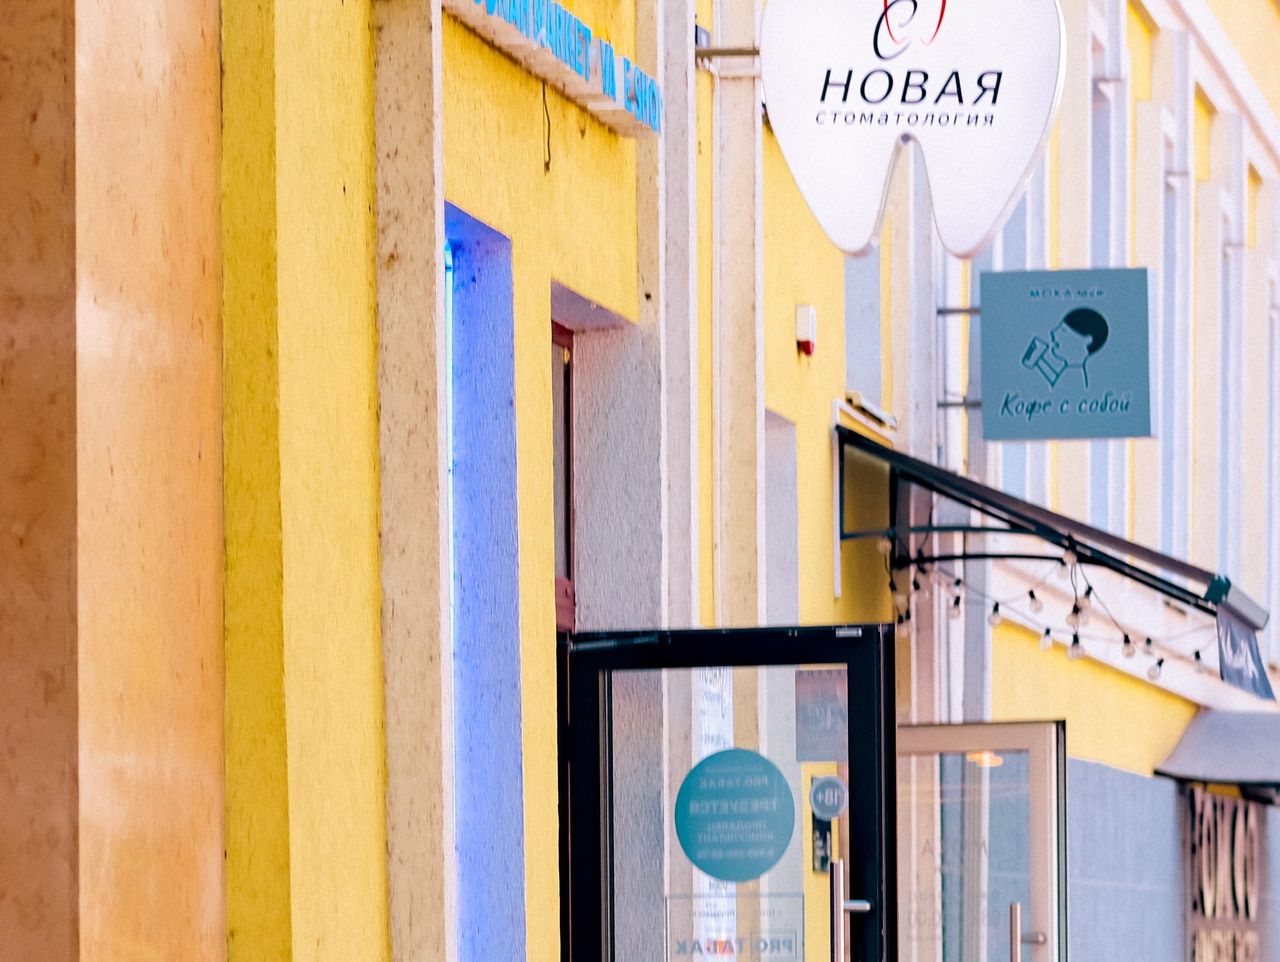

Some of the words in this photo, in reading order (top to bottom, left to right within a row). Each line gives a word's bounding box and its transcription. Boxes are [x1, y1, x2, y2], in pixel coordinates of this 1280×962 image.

[820, 68, 1003, 106] НОВАЯ
[1000, 392, 1052, 422] Кофе
[1059, 398, 1070, 415] с
[1077, 390, 1131, 415] собой
